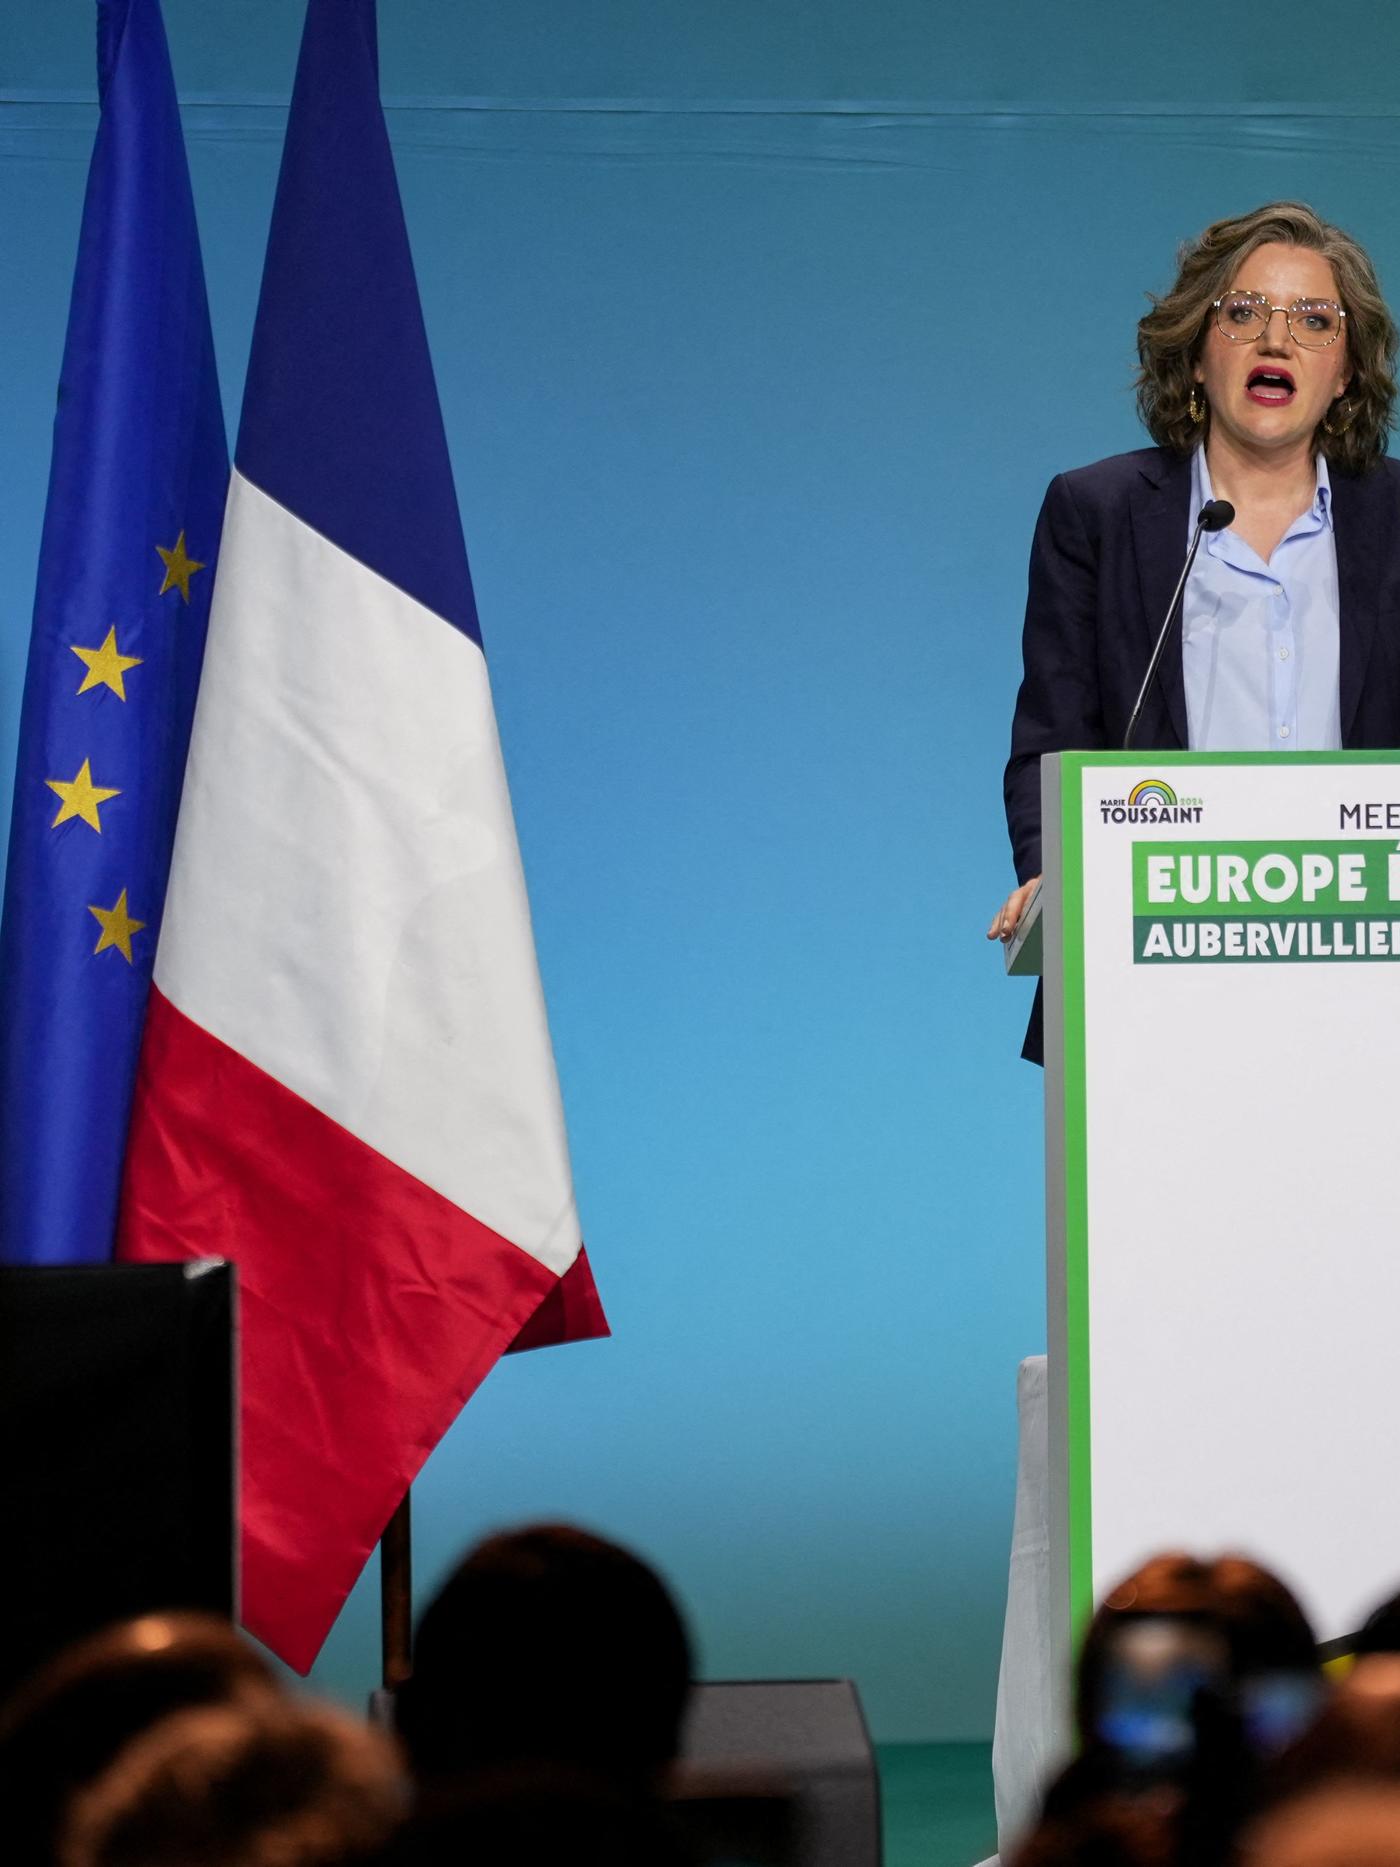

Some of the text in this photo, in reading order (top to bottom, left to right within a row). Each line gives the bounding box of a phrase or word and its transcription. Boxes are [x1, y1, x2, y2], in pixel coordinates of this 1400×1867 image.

[1100, 799, 1126, 807] MARIE
[1179, 797, 1204, 806] 2024
[1100, 807, 1204, 824] TOUSSAINT
[1147, 853, 1368, 904] EUROPE
